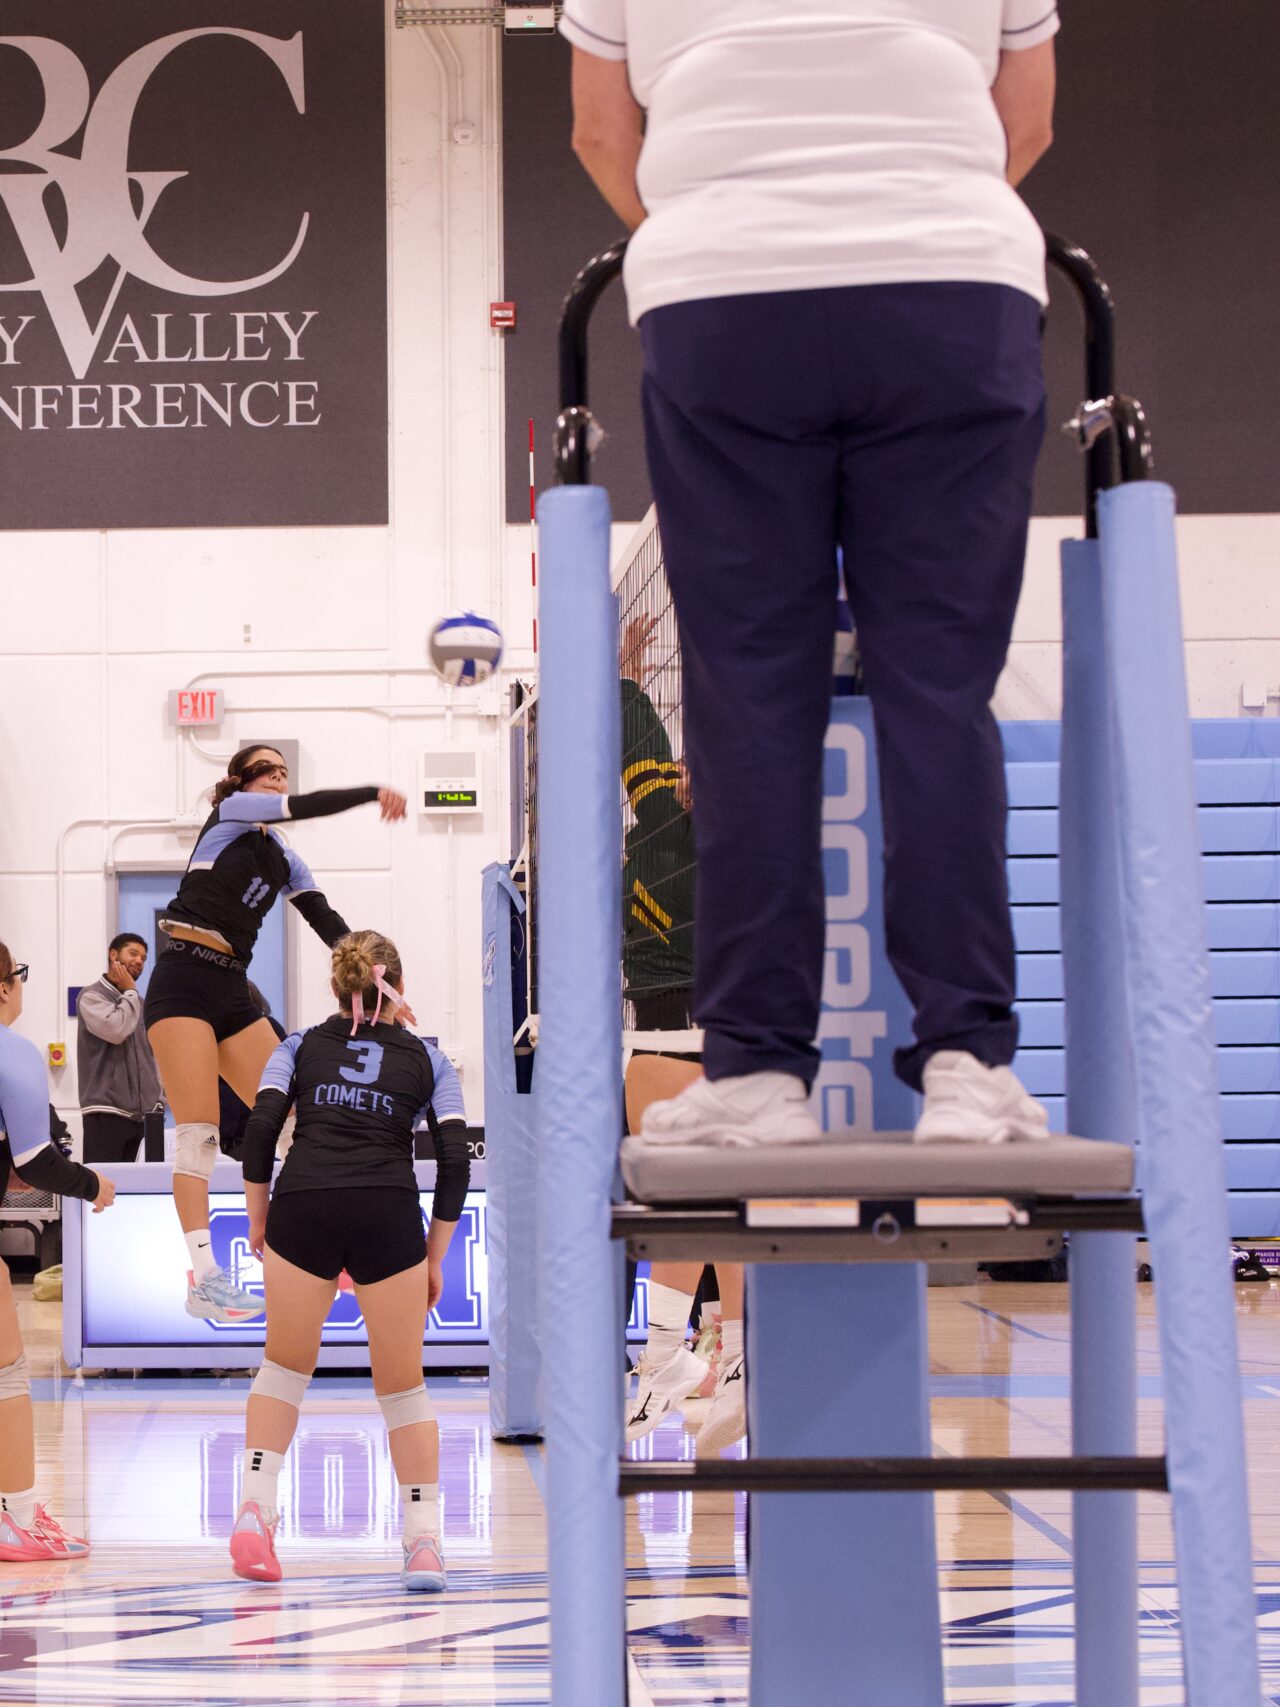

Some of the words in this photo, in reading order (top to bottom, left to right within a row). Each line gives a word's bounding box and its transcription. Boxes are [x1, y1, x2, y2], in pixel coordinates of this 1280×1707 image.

[177, 691, 217, 721] EXIT
[241, 876, 270, 909] 11
[166, 940, 186, 951] RO
[191, 946, 230, 968] NIKE
[338, 1040, 385, 1085] 3
[313, 1083, 395, 1116] COMETS
